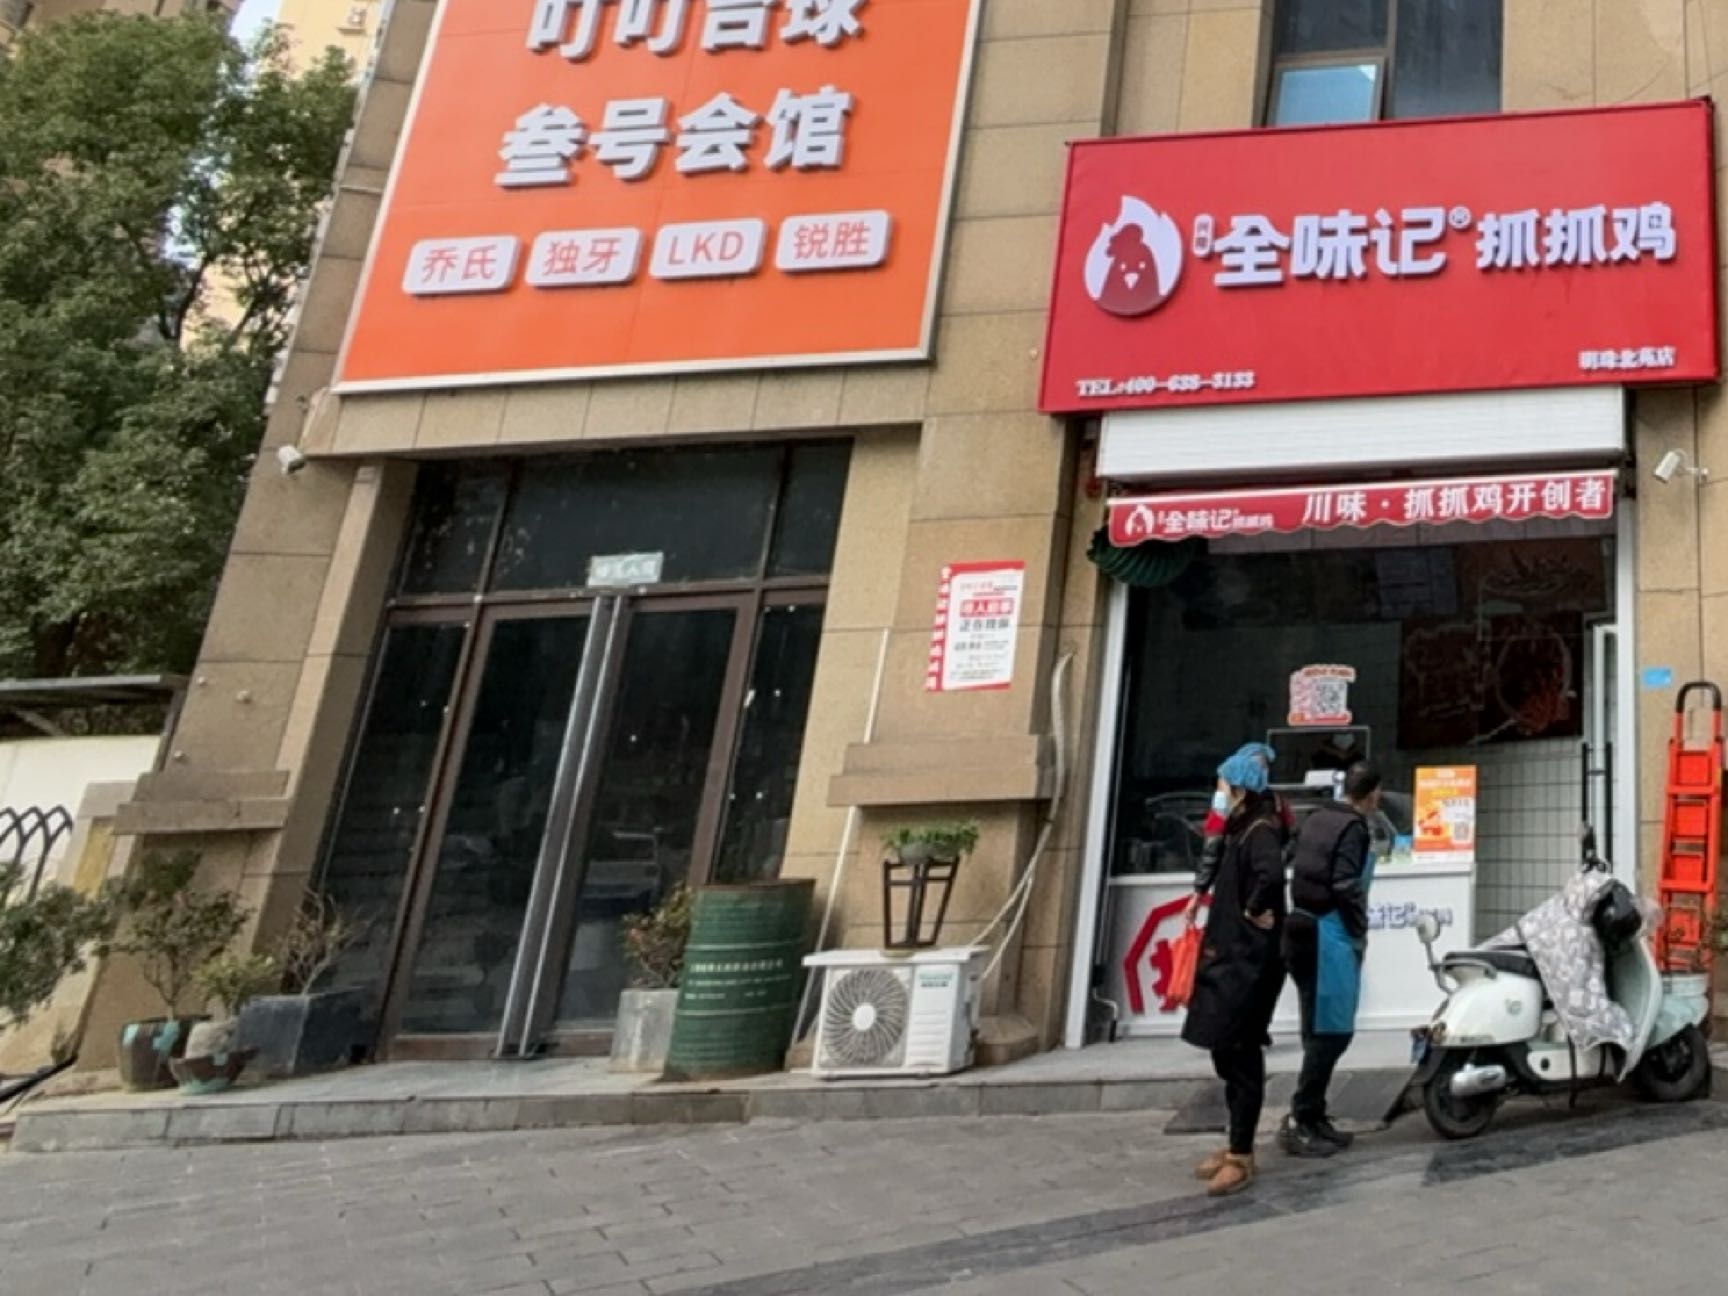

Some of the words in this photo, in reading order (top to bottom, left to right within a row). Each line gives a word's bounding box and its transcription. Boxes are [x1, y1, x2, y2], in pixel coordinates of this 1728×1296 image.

[495, 86, 852, 187] 叁号会馆
[421, 246, 498, 283] 乔氏
[542, 237, 622, 277] 独牙
[667, 229, 744, 264] LKD
[793, 220, 872, 260] 锐胜
[1213, 206, 1448, 287] 全味记
[1475, 200, 1678, 271] 抓抓鸡
